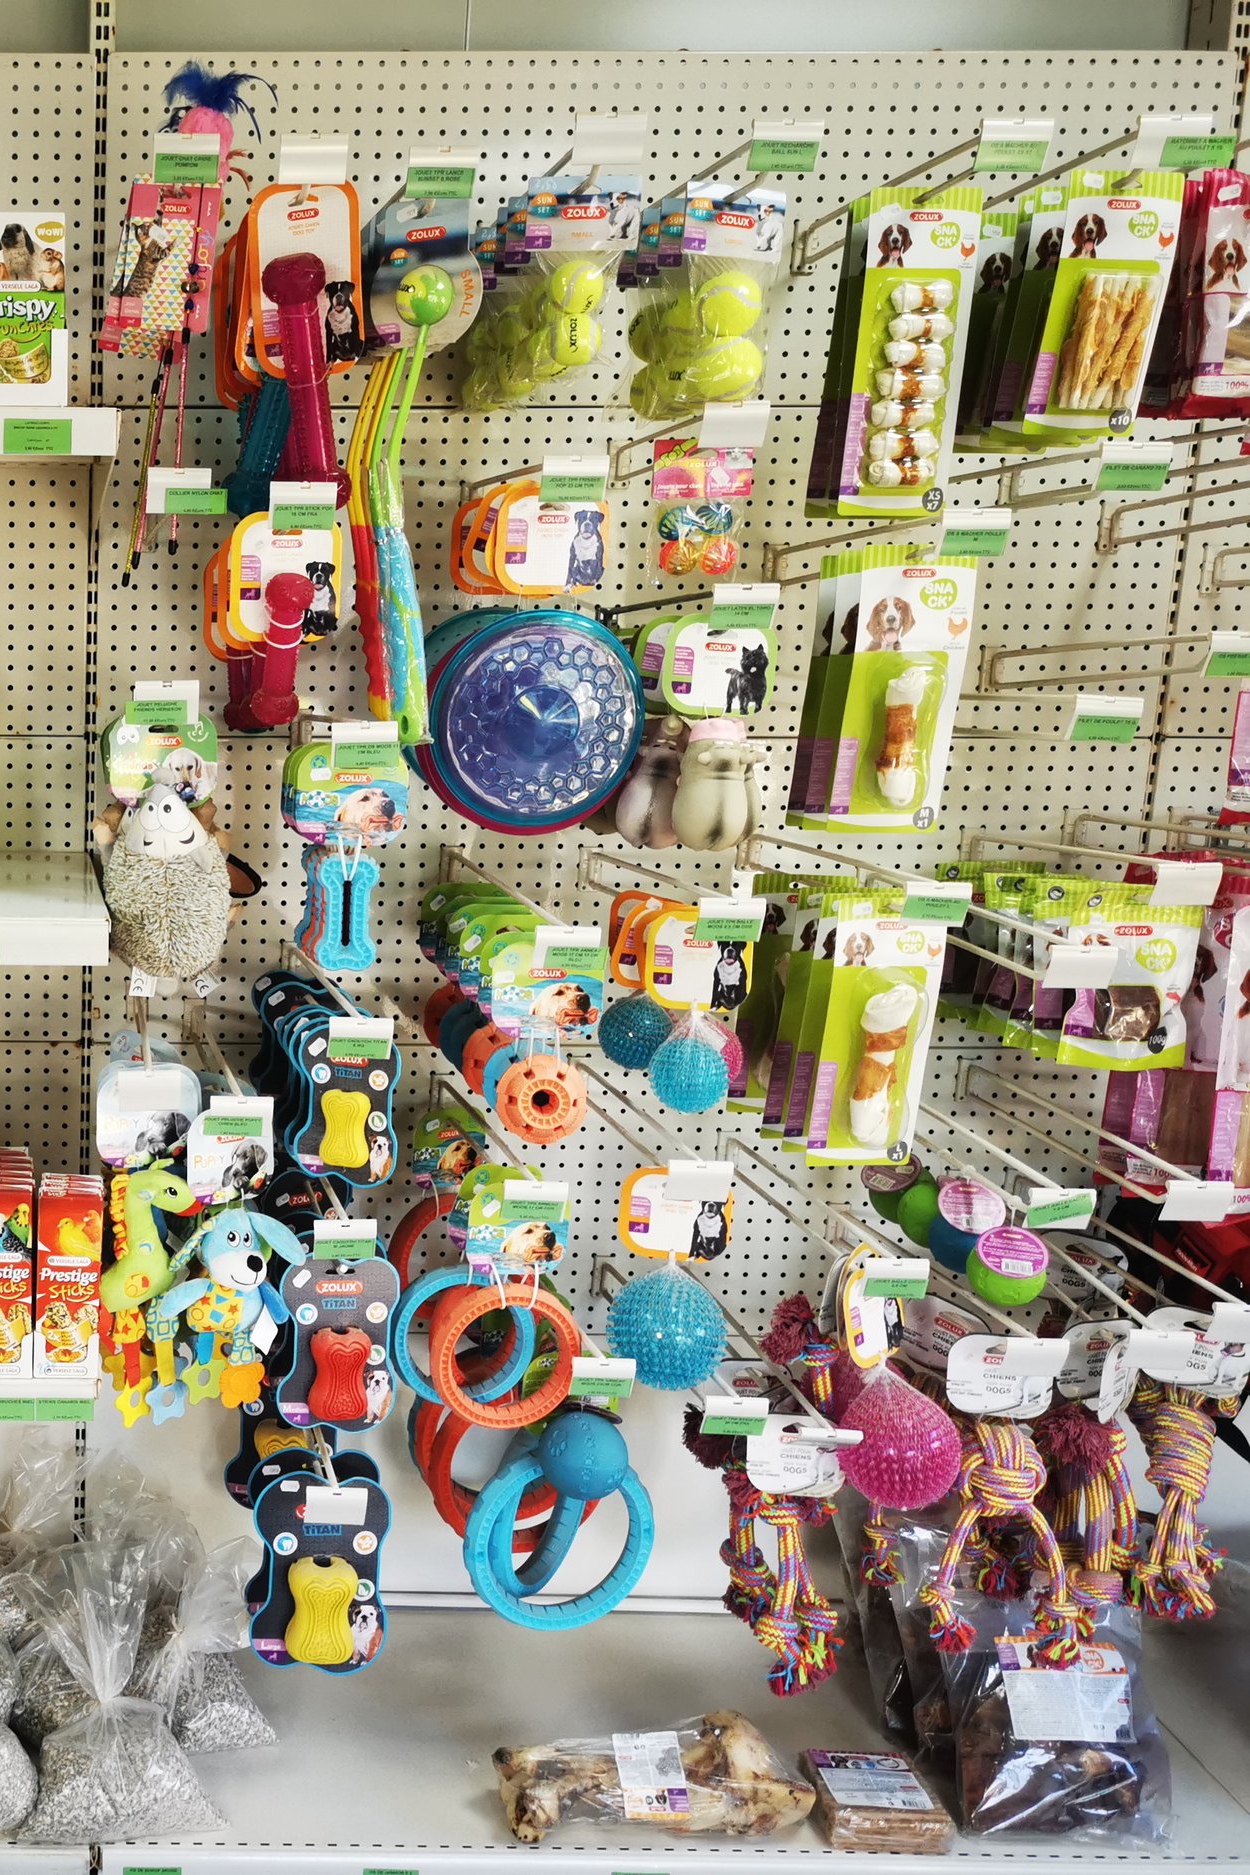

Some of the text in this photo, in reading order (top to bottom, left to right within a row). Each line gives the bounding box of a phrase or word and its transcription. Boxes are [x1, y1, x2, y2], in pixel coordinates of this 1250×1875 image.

[537, 195, 553, 205] SUN
[1112, 199, 1139, 210] ZOLUX
[164, 203, 190, 214] ZOLUX
[566, 206, 602, 219] ZOLUX
[291, 209, 318, 219] ZOLUX
[913, 212, 939, 222] ZOLUX
[720, 214, 751, 228] ZOLUX
[411, 228, 442, 240] ZOLUX
[458, 268, 471, 317] SMALL
[1111, 414, 1131, 426] x10
[927, 491, 942, 501] XS
[925, 501, 939, 511] x7
[540, 515, 567, 525] ZOLUX
[905, 569, 934, 578] ZOLUX
[924, 582, 954, 595] SNA
[708, 643, 734, 652] ZOLUX
[149, 736, 178, 747] ZOLUX
[338, 774, 368, 784] ZOLUX
[1119, 926, 1149, 936] ZOLUX
[532, 969, 562, 978] ZOLUX
[896, 1143, 902, 1152] L
[891, 1151, 903, 1160] x1
[40, 1267, 99, 1288] Prestige
[321, 1282, 357, 1292] ZOLUX
[49, 1283, 96, 1303] Sticks
[986, 1385, 1012, 1394] DOGS
[780, 1453, 812, 1461] CHIENS
[783, 1466, 808, 1474] DOGS
